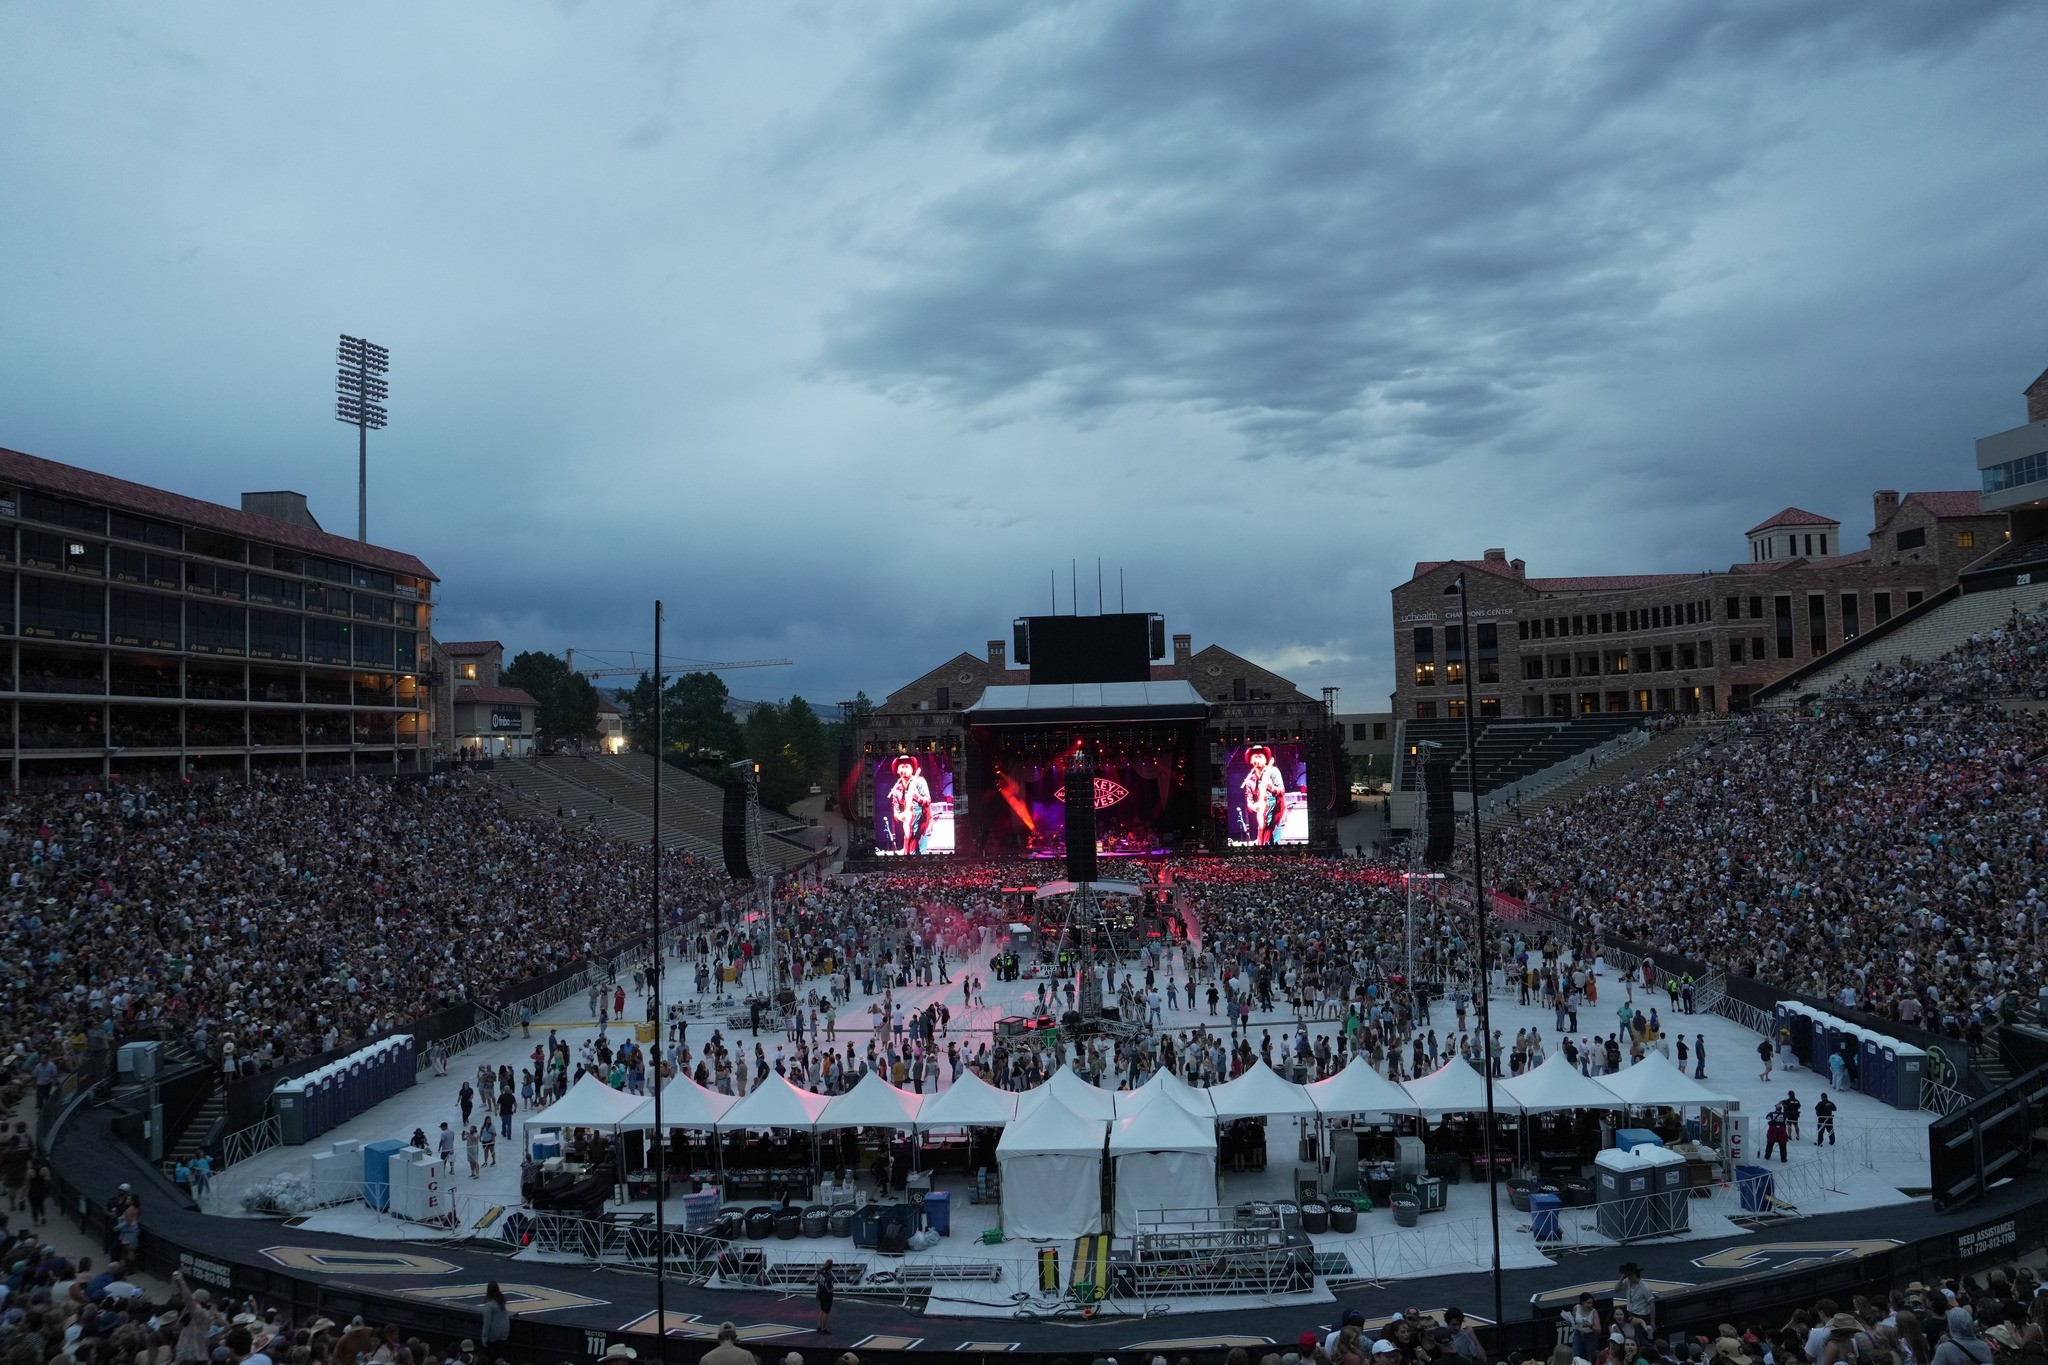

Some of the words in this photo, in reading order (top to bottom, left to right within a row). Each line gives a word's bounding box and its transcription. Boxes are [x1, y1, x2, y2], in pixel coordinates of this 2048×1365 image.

[1486, 608, 1514, 616] CENTER
[1731, 1120, 1742, 1159] ICE
[428, 1167, 438, 1208] ICE
[1958, 1233, 1976, 1247] NEED
[1976, 1220, 2015, 1242] ASSISTANCE?
[1959, 1245, 1974, 1259] Text
[1974, 1231, 2016, 1254] 720-812-1769
[584, 1330, 607, 1338] SECTION
[587, 1336, 606, 1356] 111
